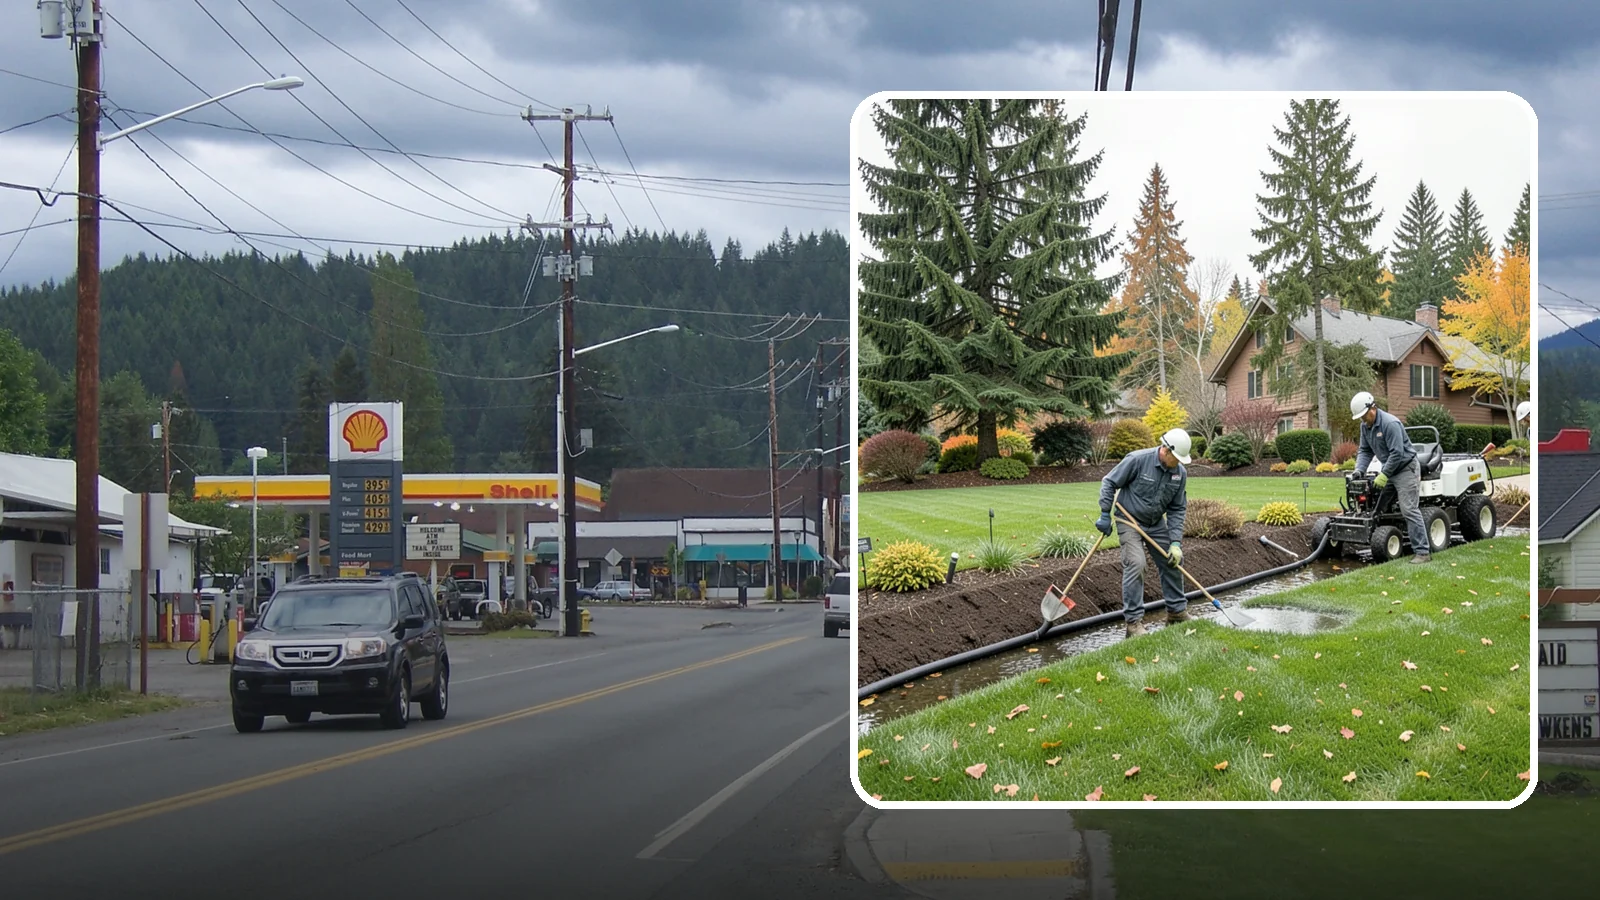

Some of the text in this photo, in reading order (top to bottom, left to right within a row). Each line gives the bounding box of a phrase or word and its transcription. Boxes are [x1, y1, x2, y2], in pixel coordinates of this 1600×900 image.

[366, 480, 383, 490] 395
[490, 484, 547, 499] Shell
[366, 494, 383, 504] 405
[366, 508, 383, 518] 415
[366, 522, 383, 532] 429
